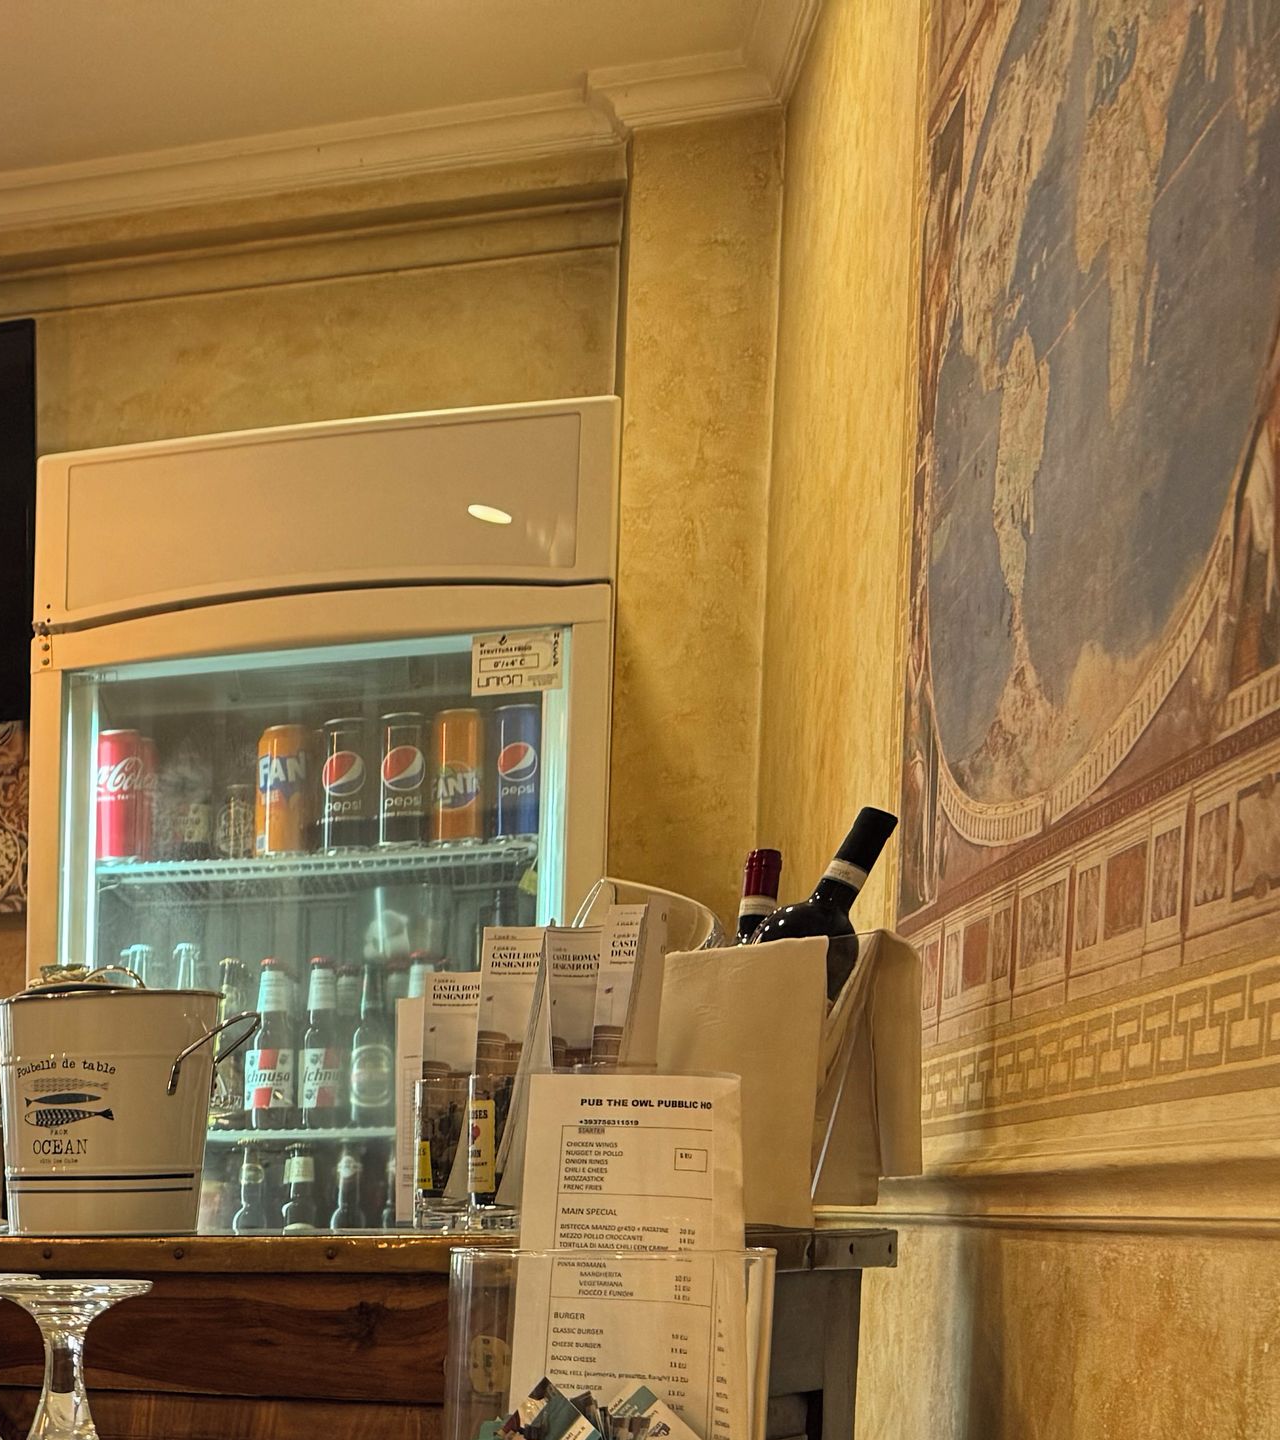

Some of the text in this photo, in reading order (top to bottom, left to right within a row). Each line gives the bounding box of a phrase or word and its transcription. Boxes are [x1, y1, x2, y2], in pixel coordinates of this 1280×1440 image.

[258, 751, 306, 789] FAN
[501, 783, 535, 797] pepsi
[325, 799, 362, 814] pepsi
[384, 794, 422, 810] pepsi
[492, 952, 541, 960] CASTEL ROM
[491, 960, 532, 968] DESIGNER
[433, 984, 480, 992] CASTEL ROM
[16, 1058, 117, 1079] Poubelle de table
[247, 1070, 290, 1083] chnusa
[580, 1098, 713, 1110] PUB THE OWL PUBBLIC HO
[578, 1127, 605, 1135] STARTER
[32, 1139, 88, 1155] OCEAN
[561, 1207, 618, 1216] MAIN SPECIAL
[560, 1223, 590, 1231] BISTECCA
[605, 1233, 643, 1241] CROCCANTE
[553, 1311, 586, 1320] BURGER
[575, 1341, 602, 1349] BURGER
